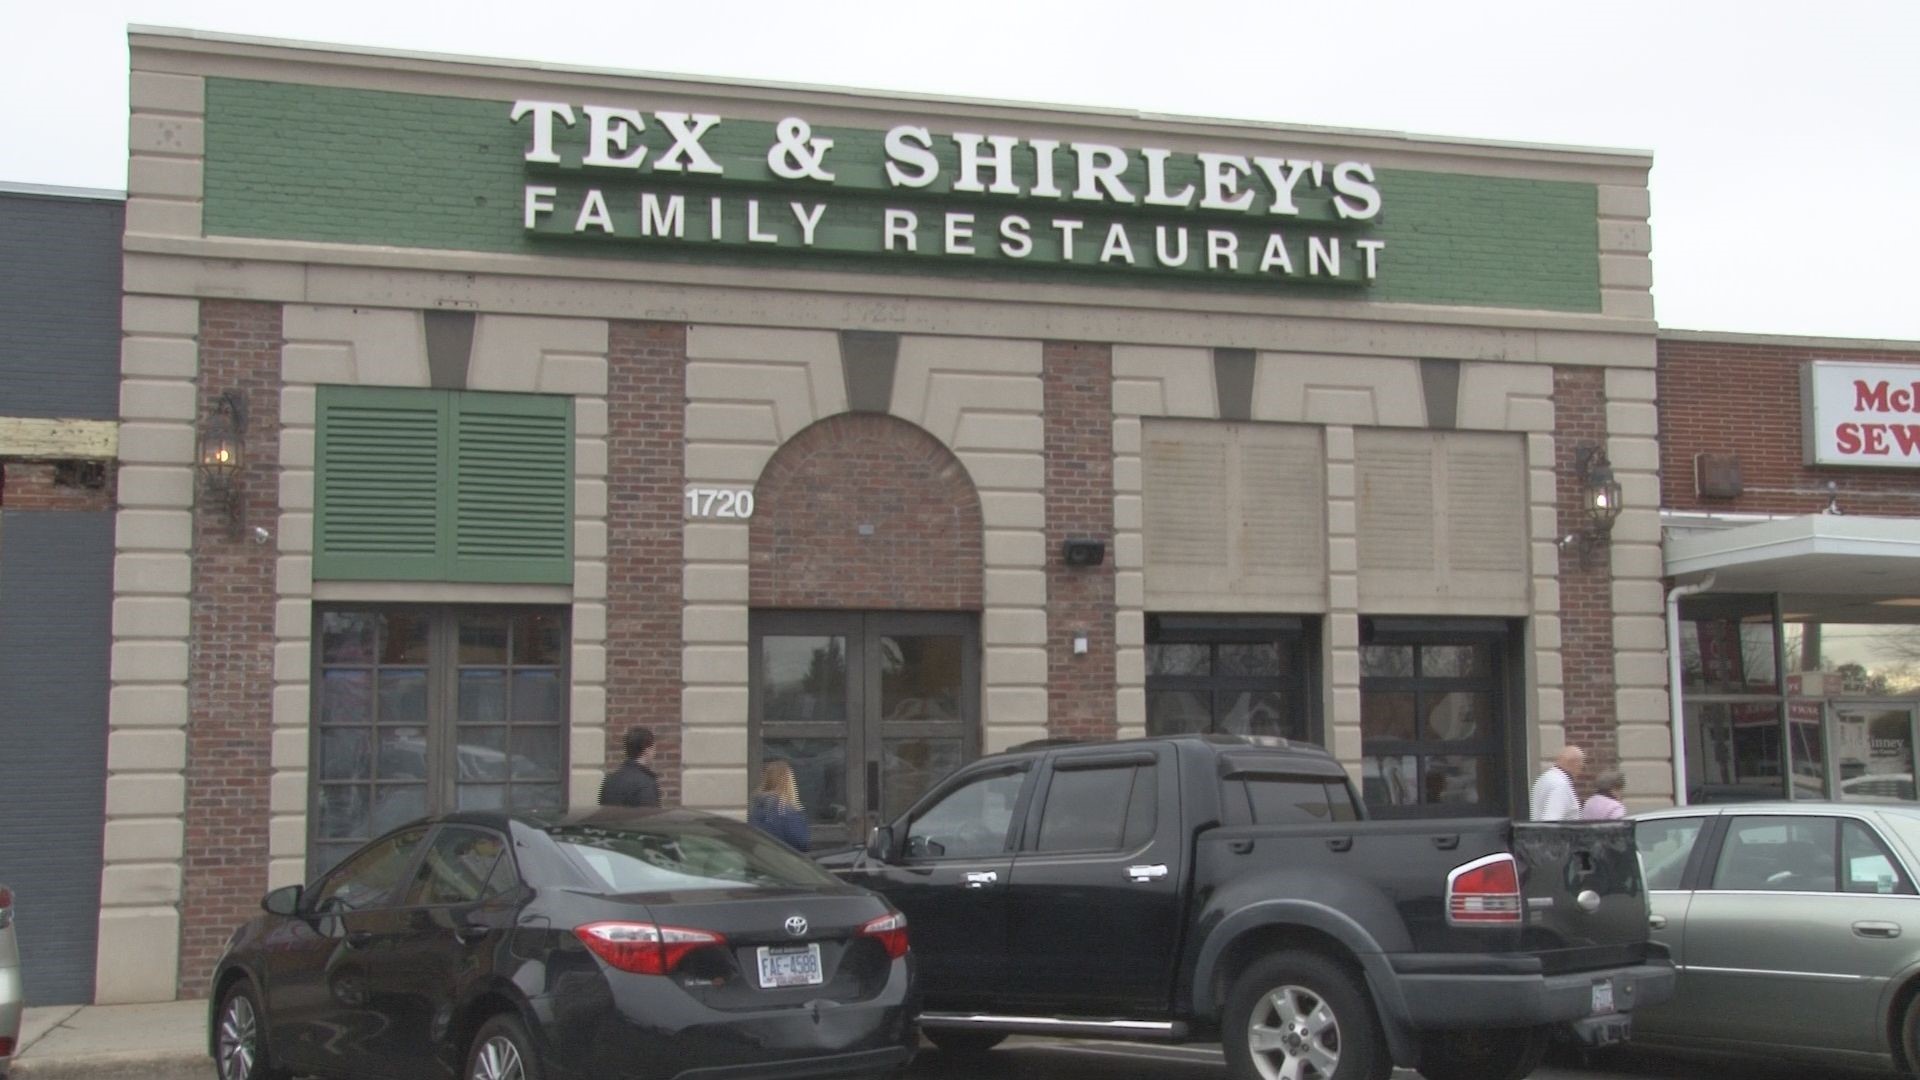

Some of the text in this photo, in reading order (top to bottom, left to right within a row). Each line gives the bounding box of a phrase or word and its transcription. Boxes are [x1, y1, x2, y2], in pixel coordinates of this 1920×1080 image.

[510, 100, 1383, 221] TEX & SHIRLEY'S
[524, 185, 1385, 280] FAMILY RESTAURANT
[685, 488, 754, 519] 1720
